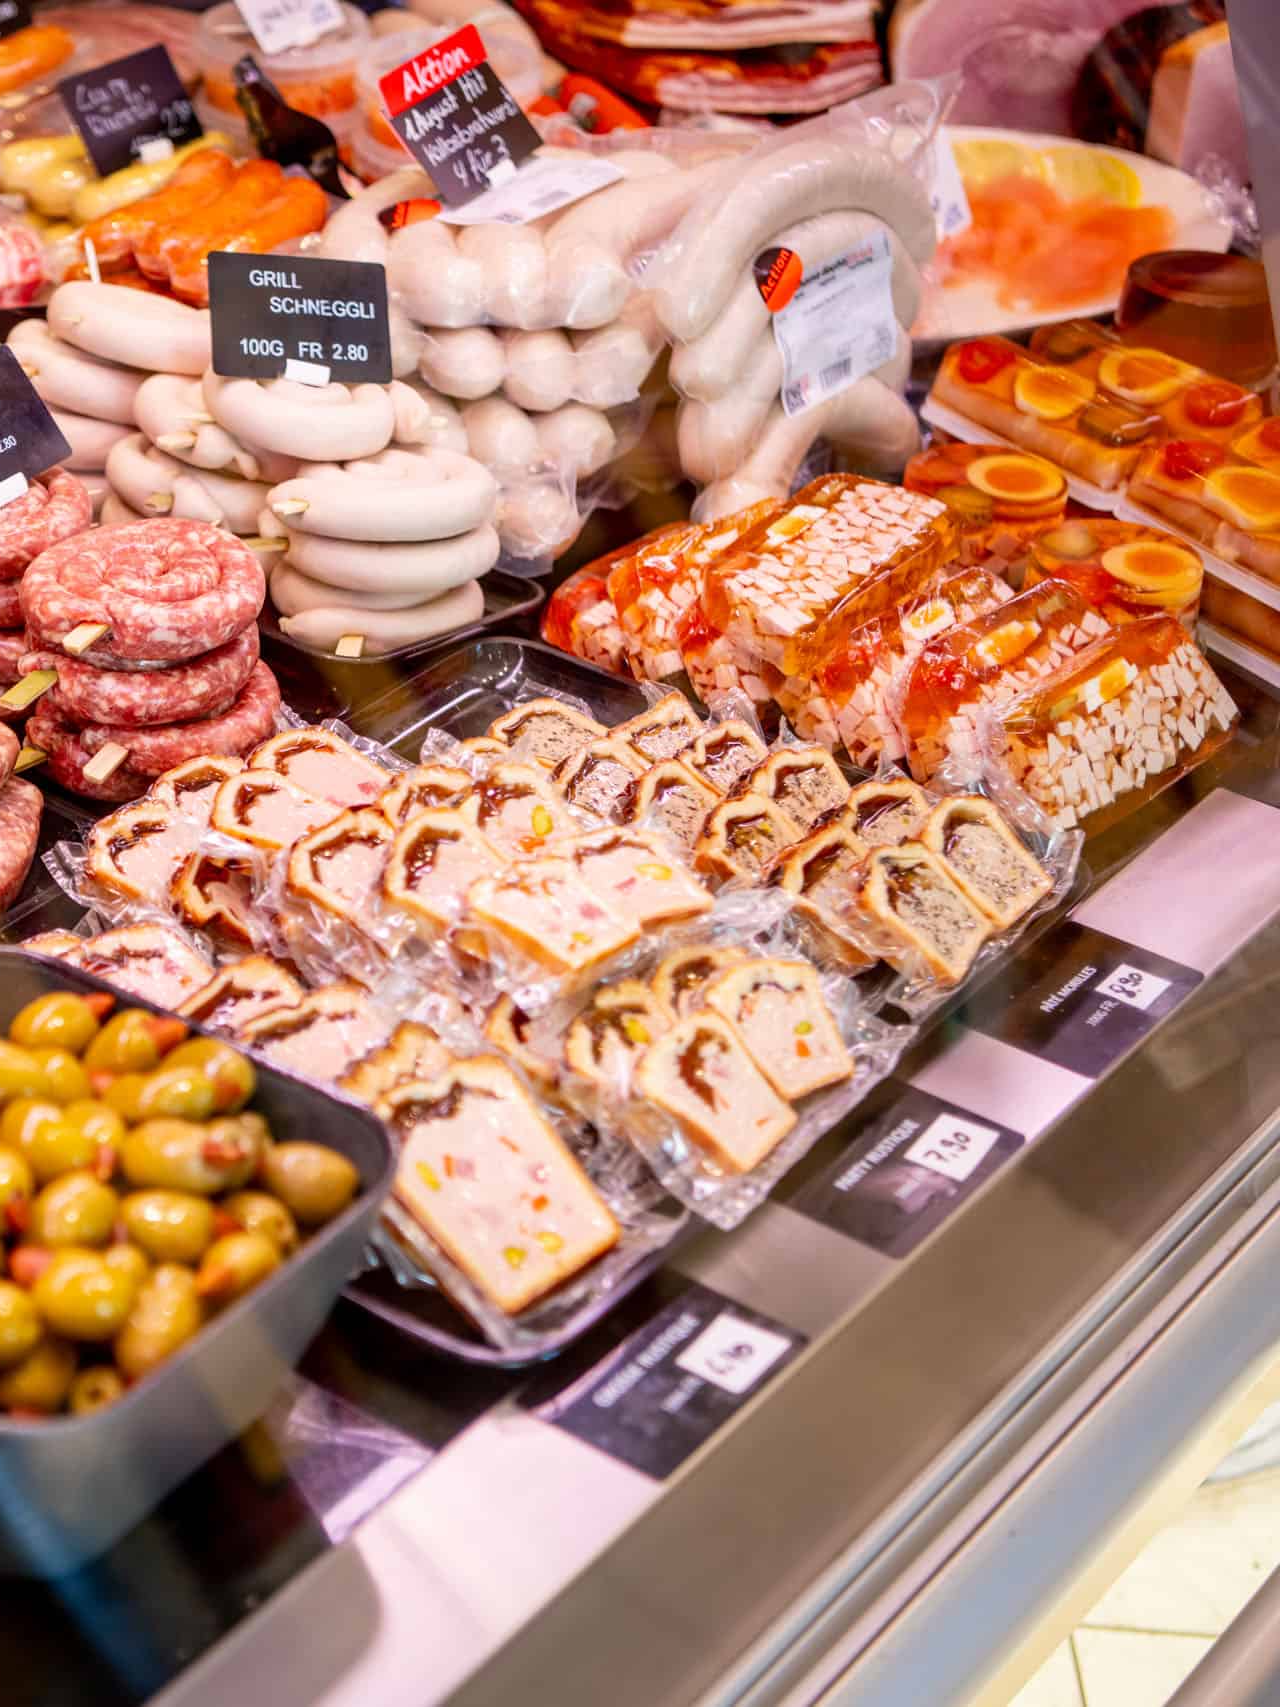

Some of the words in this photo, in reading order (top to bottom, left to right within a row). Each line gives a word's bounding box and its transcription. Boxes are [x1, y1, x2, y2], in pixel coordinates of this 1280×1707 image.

[402, 47, 470, 102] Aktion
[452, 159, 470, 187] 4
[249, 269, 302, 289] GRILL
[760, 248, 791, 300] Action
[269, 296, 376, 319] SCHNEGGLI
[239, 338, 285, 357] 100G
[298, 341, 324, 359] FR
[332, 343, 369, 362] 2.80
[832, 1158, 872, 1192] PARTY
[865, 1117, 921, 1166] RUSTIQUE
